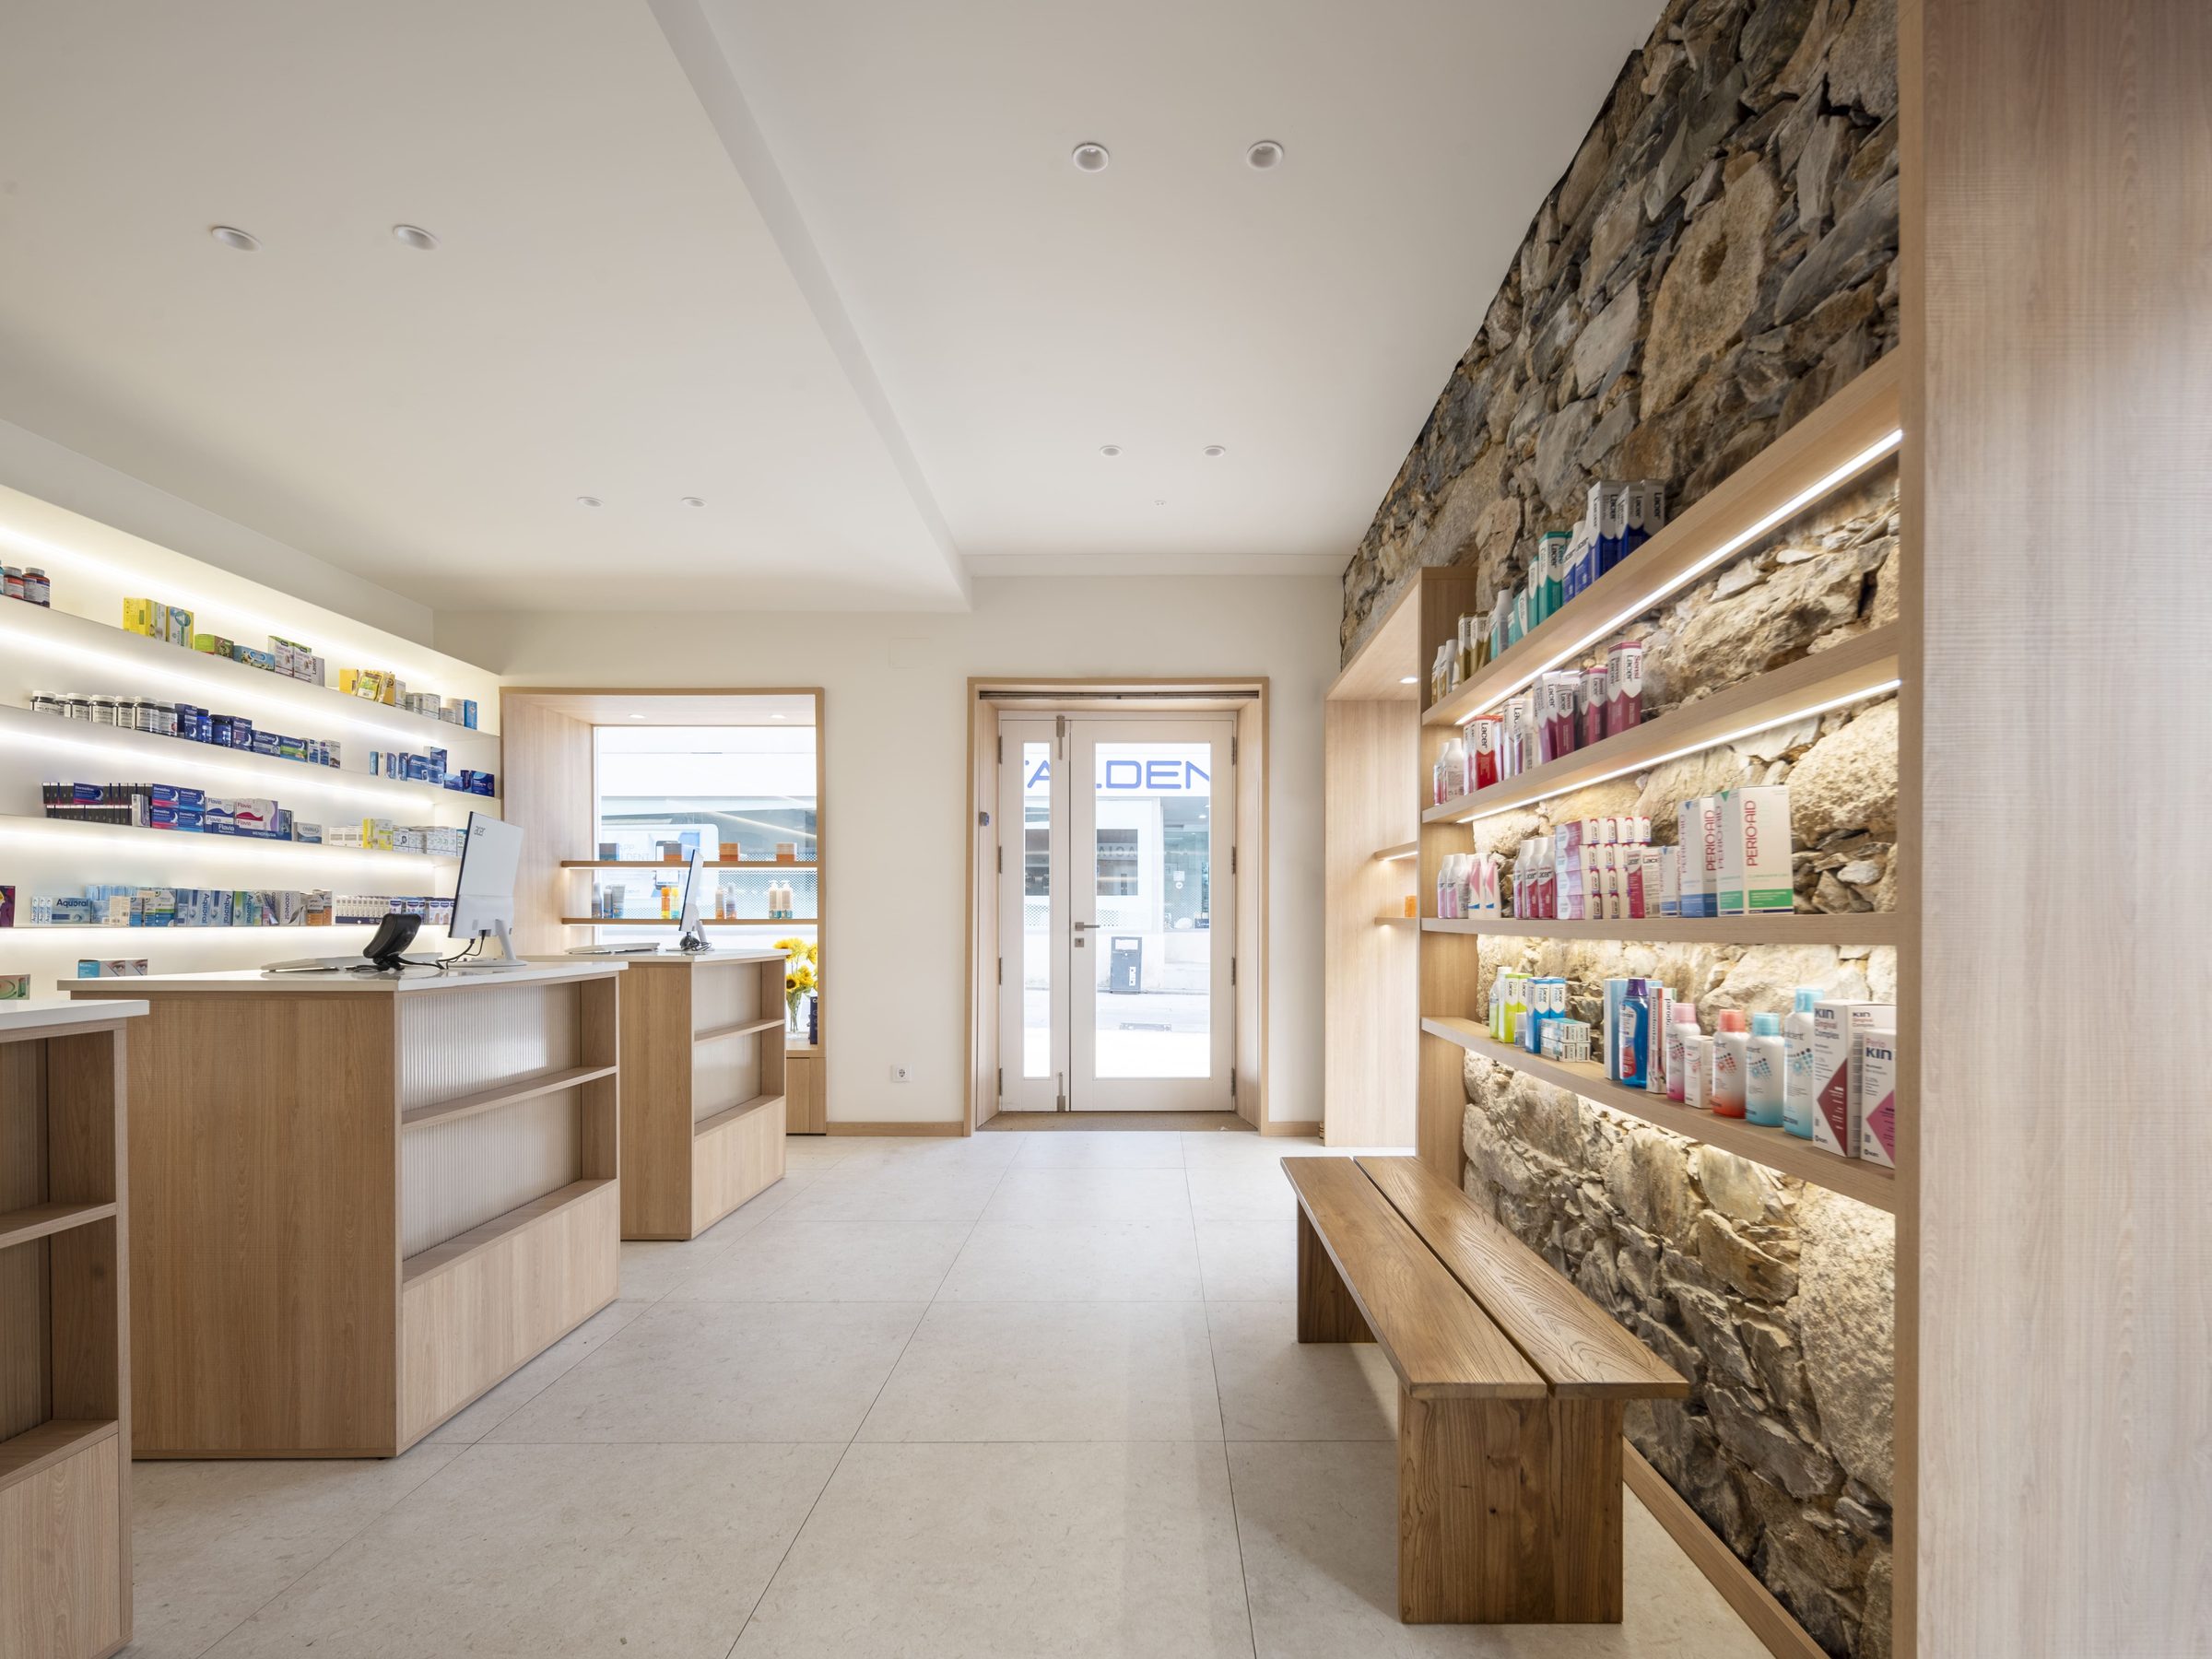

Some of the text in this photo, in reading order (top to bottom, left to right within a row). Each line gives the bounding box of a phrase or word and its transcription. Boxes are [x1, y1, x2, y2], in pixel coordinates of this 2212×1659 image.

[56, 899, 88, 908] Aquoral
[202, 893, 210, 924] Aquoral
[223, 894, 231, 924] Aquoral
[1815, 1019, 1838, 1030] Gingival
[1815, 1029, 1840, 1040] Complex
[1865, 1038, 1886, 1047] Perio
